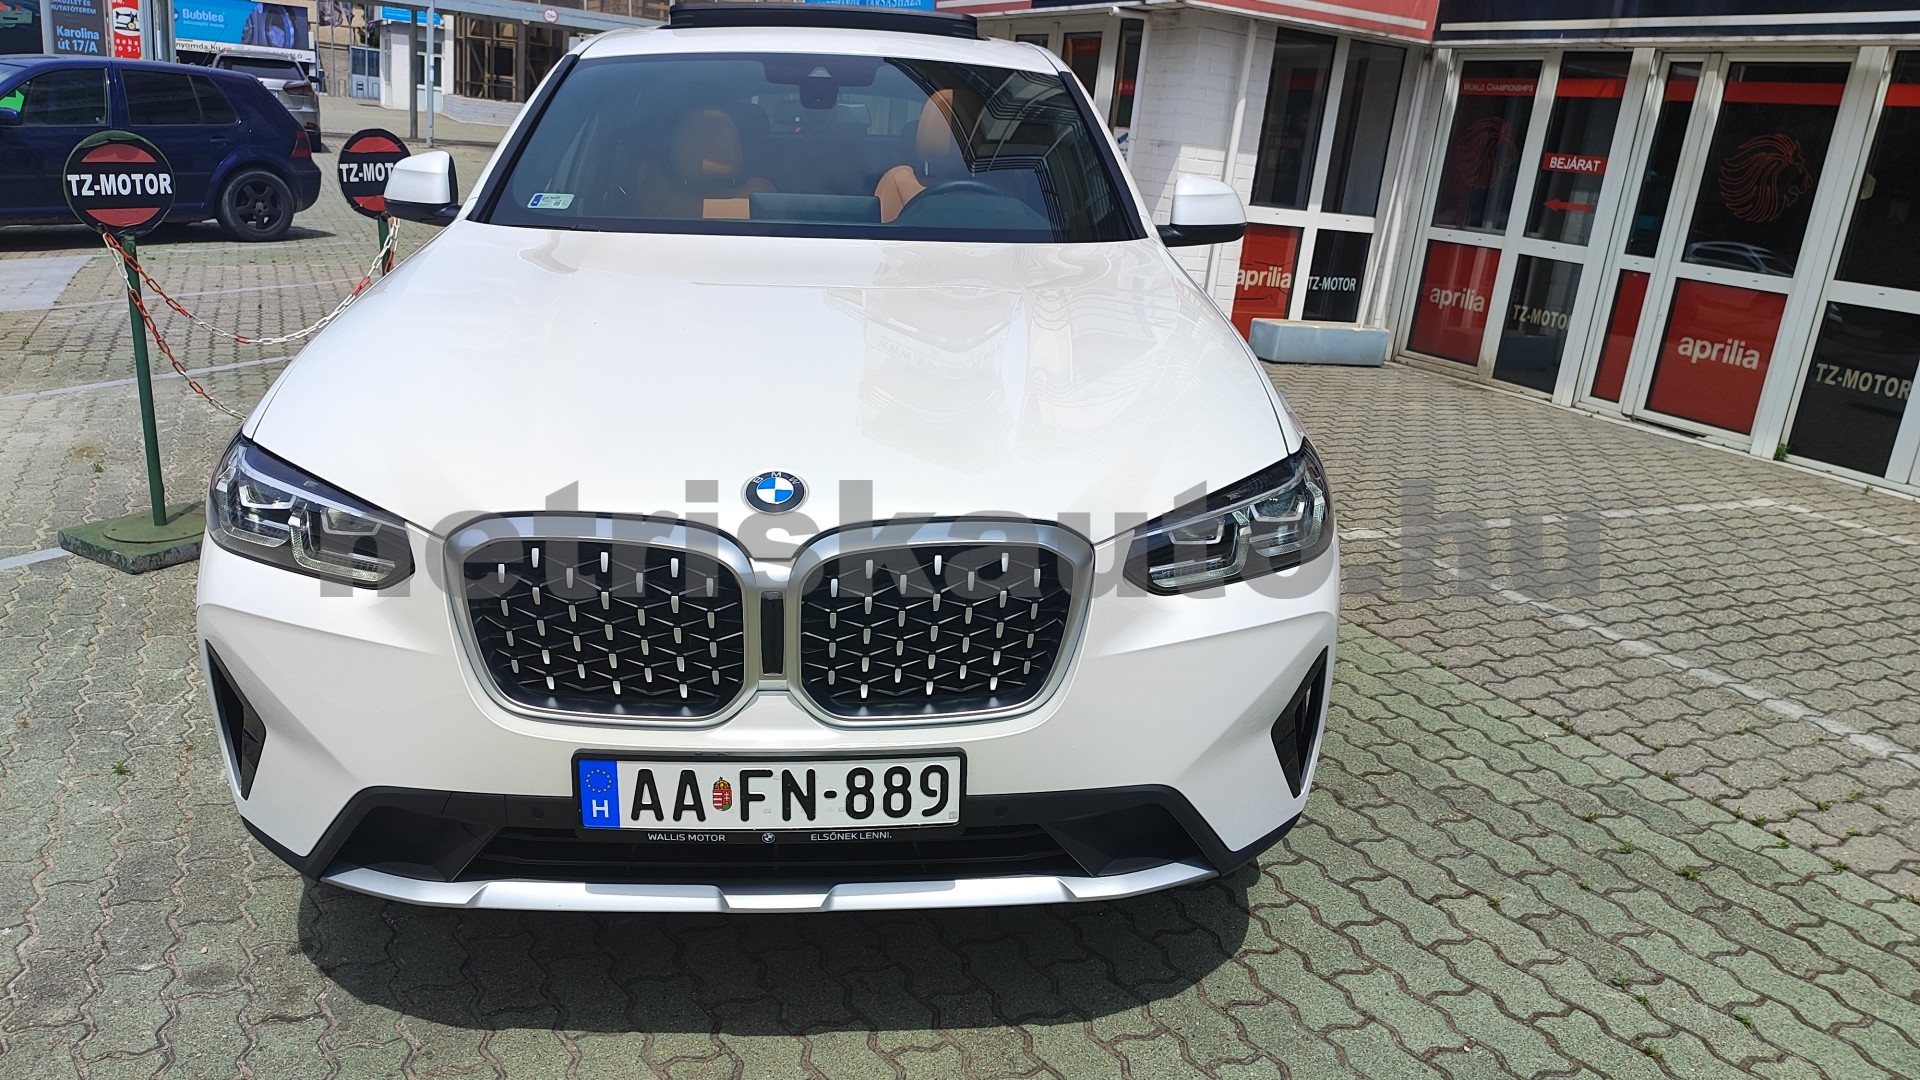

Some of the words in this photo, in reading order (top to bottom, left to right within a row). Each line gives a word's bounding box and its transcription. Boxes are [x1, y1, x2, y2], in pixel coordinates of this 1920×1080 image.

[182, 8, 224, 22] Bubbles
[56, 25, 100, 40] Karolina
[58, 37, 70, 50] út
[72, 40, 98, 53] 17/A
[176, 42, 221, 52] nyomda.hu
[1463, 83, 1485, 92] WORLD
[1549, 156, 1601, 172] BEJÁRAT
[340, 163, 394, 183] TZ-MOT
[67, 173, 173, 196] TZ-MOTOR
[1236, 266, 1292, 290] aprilia
[1308, 276, 1356, 291] TZ-MOTOR
[1429, 287, 1485, 312] aprilia
[1677, 336, 1760, 370] aprilia
[1815, 362, 1913, 400] TZ-MOTOR
[592, 799, 610, 818] H
[647, 832, 686, 841] WALLIS
[688, 833, 726, 842] MOTOR
[810, 831, 858, 841] ELSŐNEK
[859, 831, 892, 840] LENNI.
